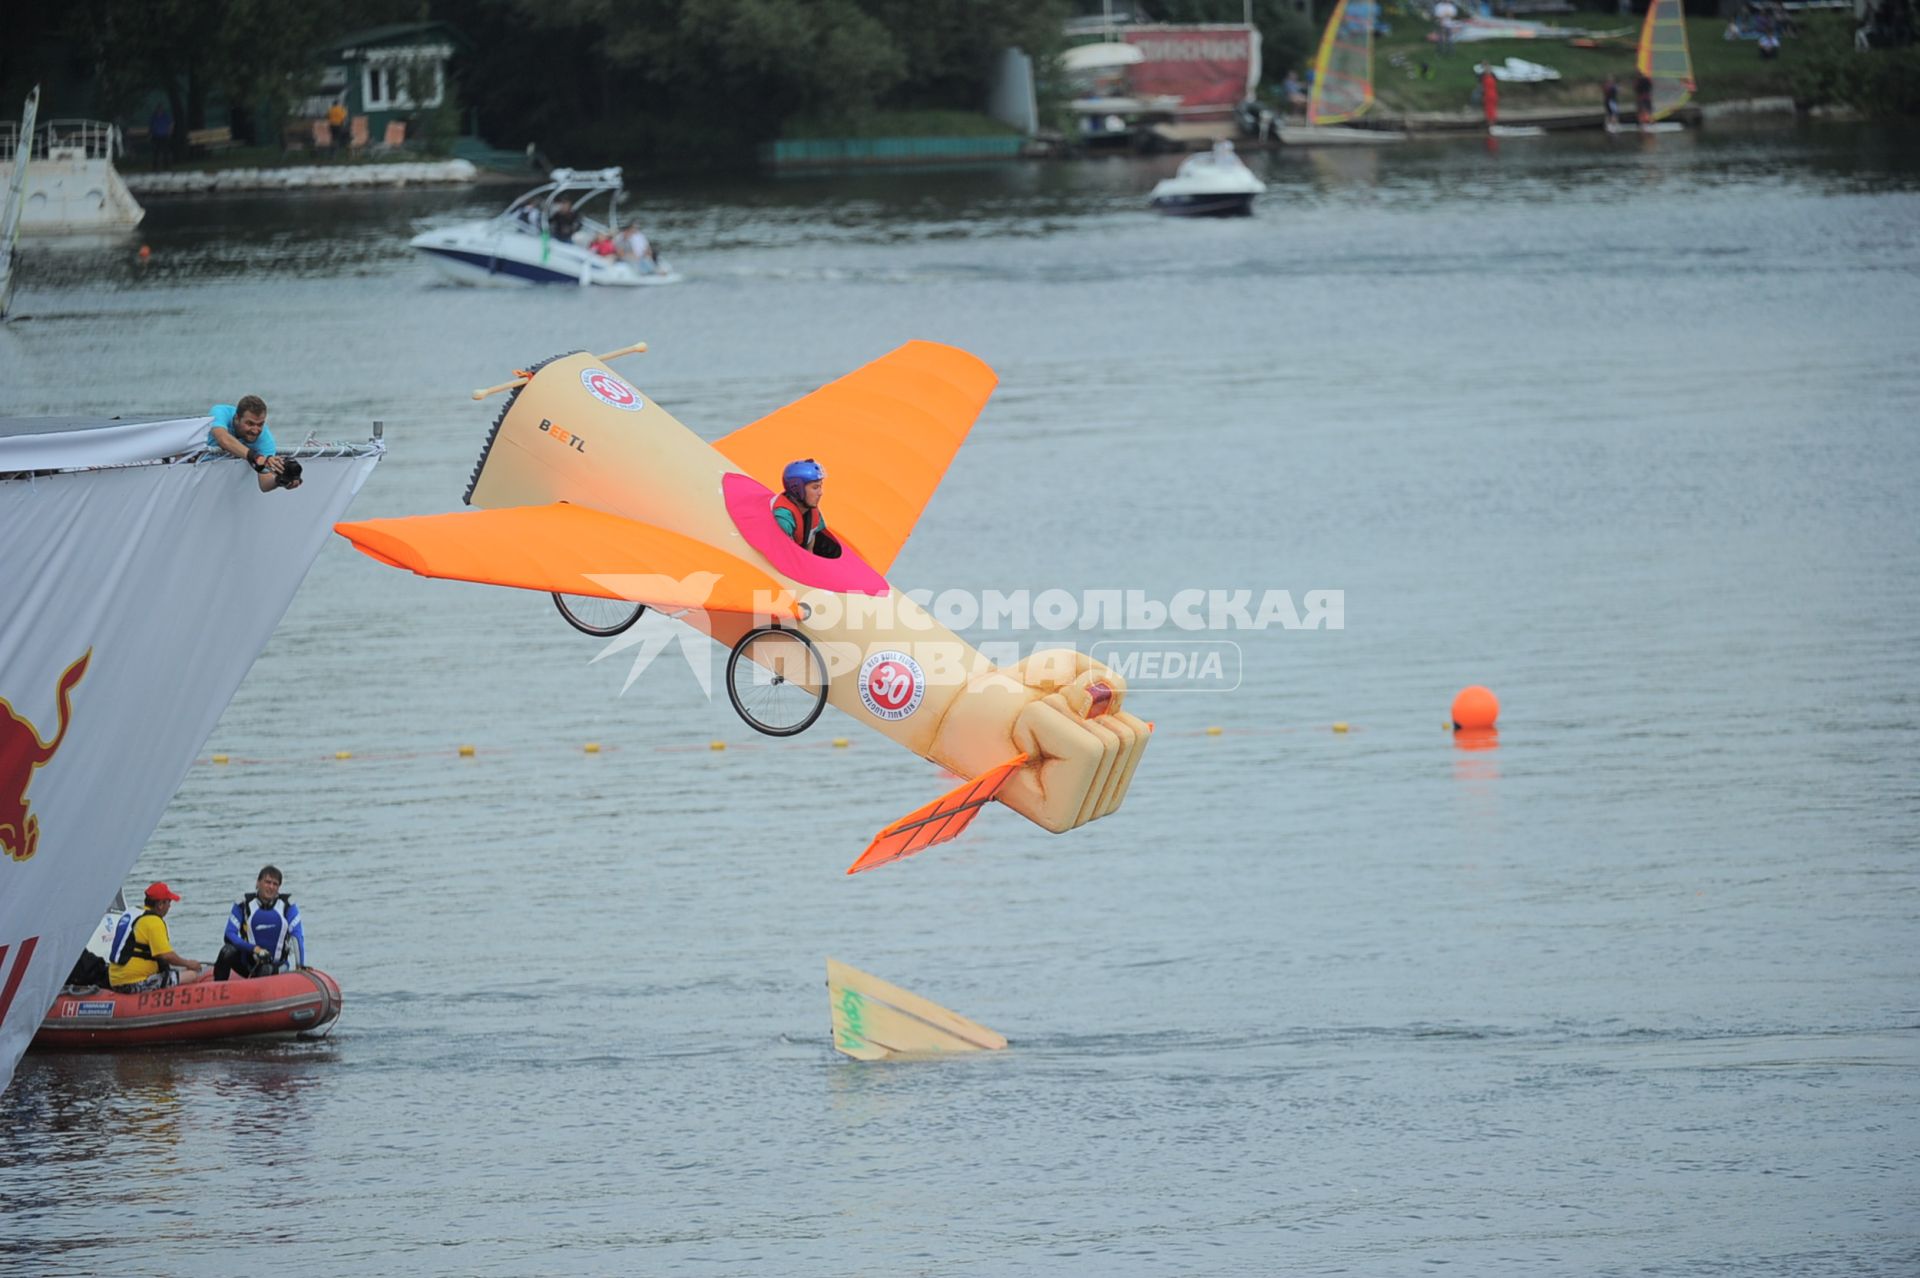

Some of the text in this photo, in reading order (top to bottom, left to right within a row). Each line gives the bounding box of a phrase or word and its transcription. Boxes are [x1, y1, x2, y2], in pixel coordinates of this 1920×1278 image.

[538, 418, 586, 454] BEETL
[872, 665, 911, 705] 30
[862, 692, 886, 717] FLUGTAG
[887, 711, 903, 719] BULL
